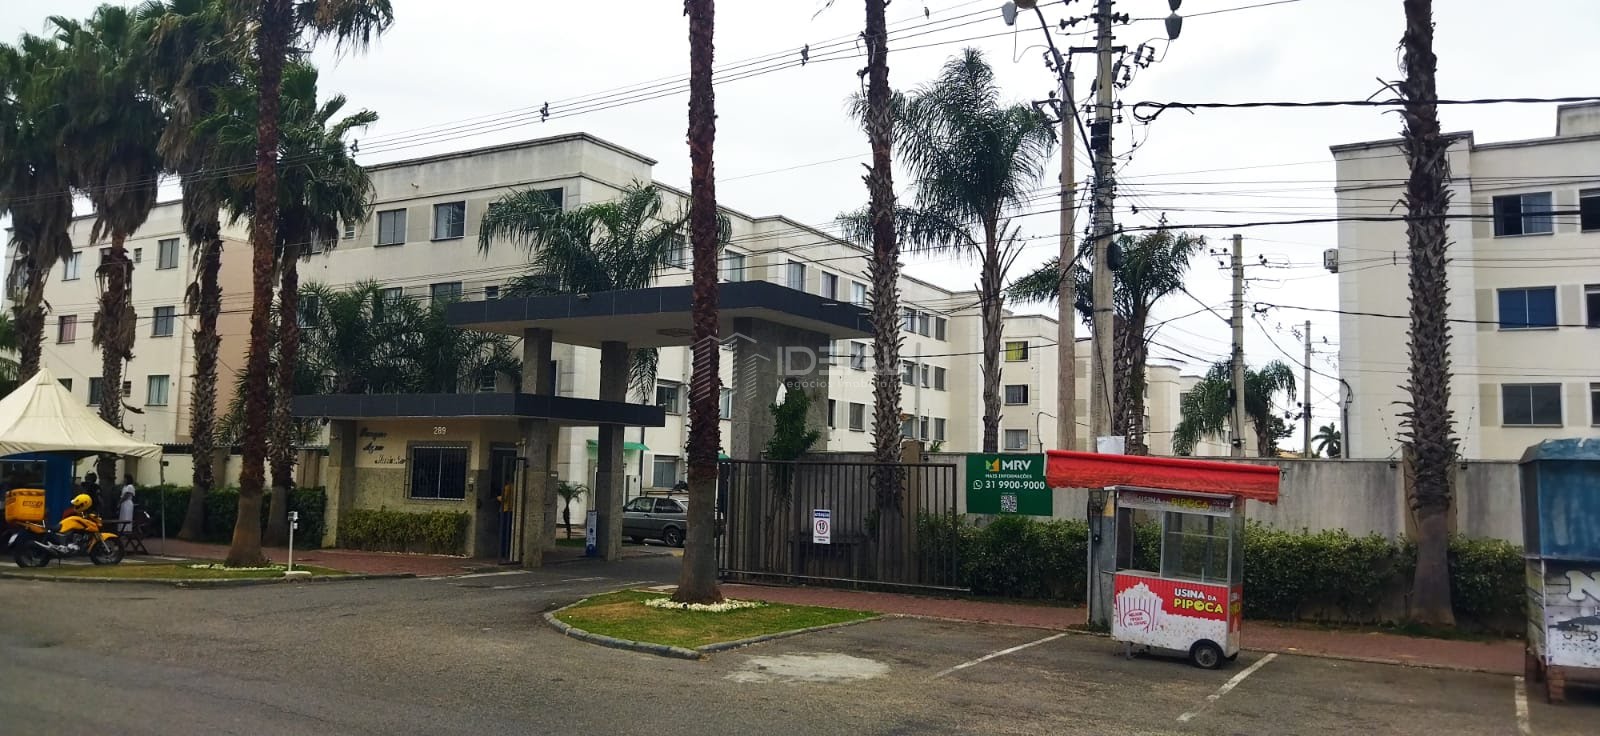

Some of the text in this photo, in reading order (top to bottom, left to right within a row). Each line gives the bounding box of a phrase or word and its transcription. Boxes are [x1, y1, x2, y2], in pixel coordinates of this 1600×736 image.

[433, 426, 446, 435] 289
[1001, 459, 1032, 471] MRV
[985, 480, 1045, 490] 31 9900-9000
[1174, 588, 1205, 600] USINA
[1173, 598, 1224, 614] PIPOCA
